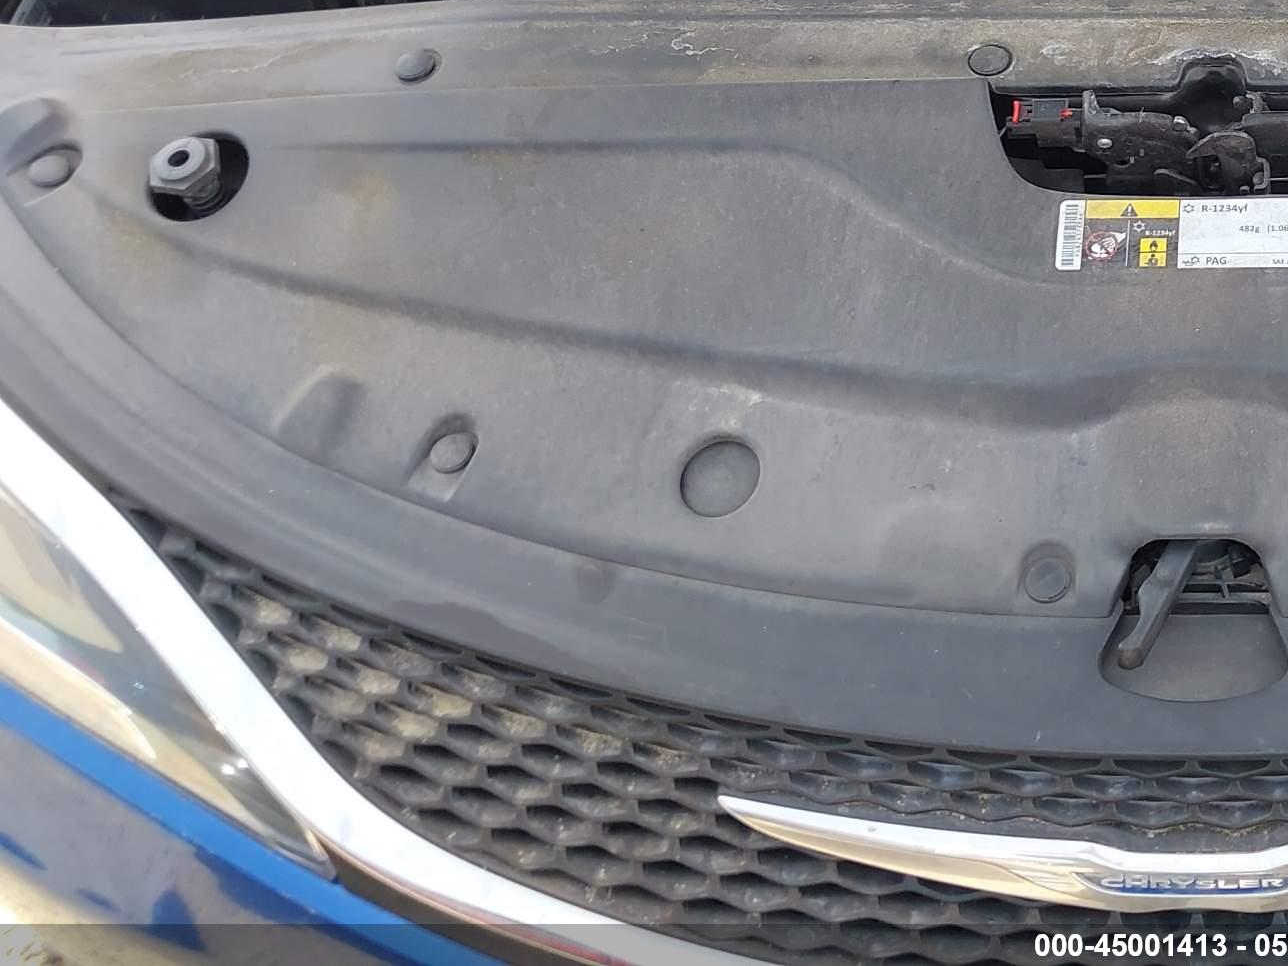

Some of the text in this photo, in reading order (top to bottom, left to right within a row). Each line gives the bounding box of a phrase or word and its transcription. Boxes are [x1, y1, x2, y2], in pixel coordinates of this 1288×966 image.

[1201, 204, 1248, 214] R-1234yf
[1205, 256, 1227, 265] PAG
[1101, 876, 1284, 890] CHRYSLER
